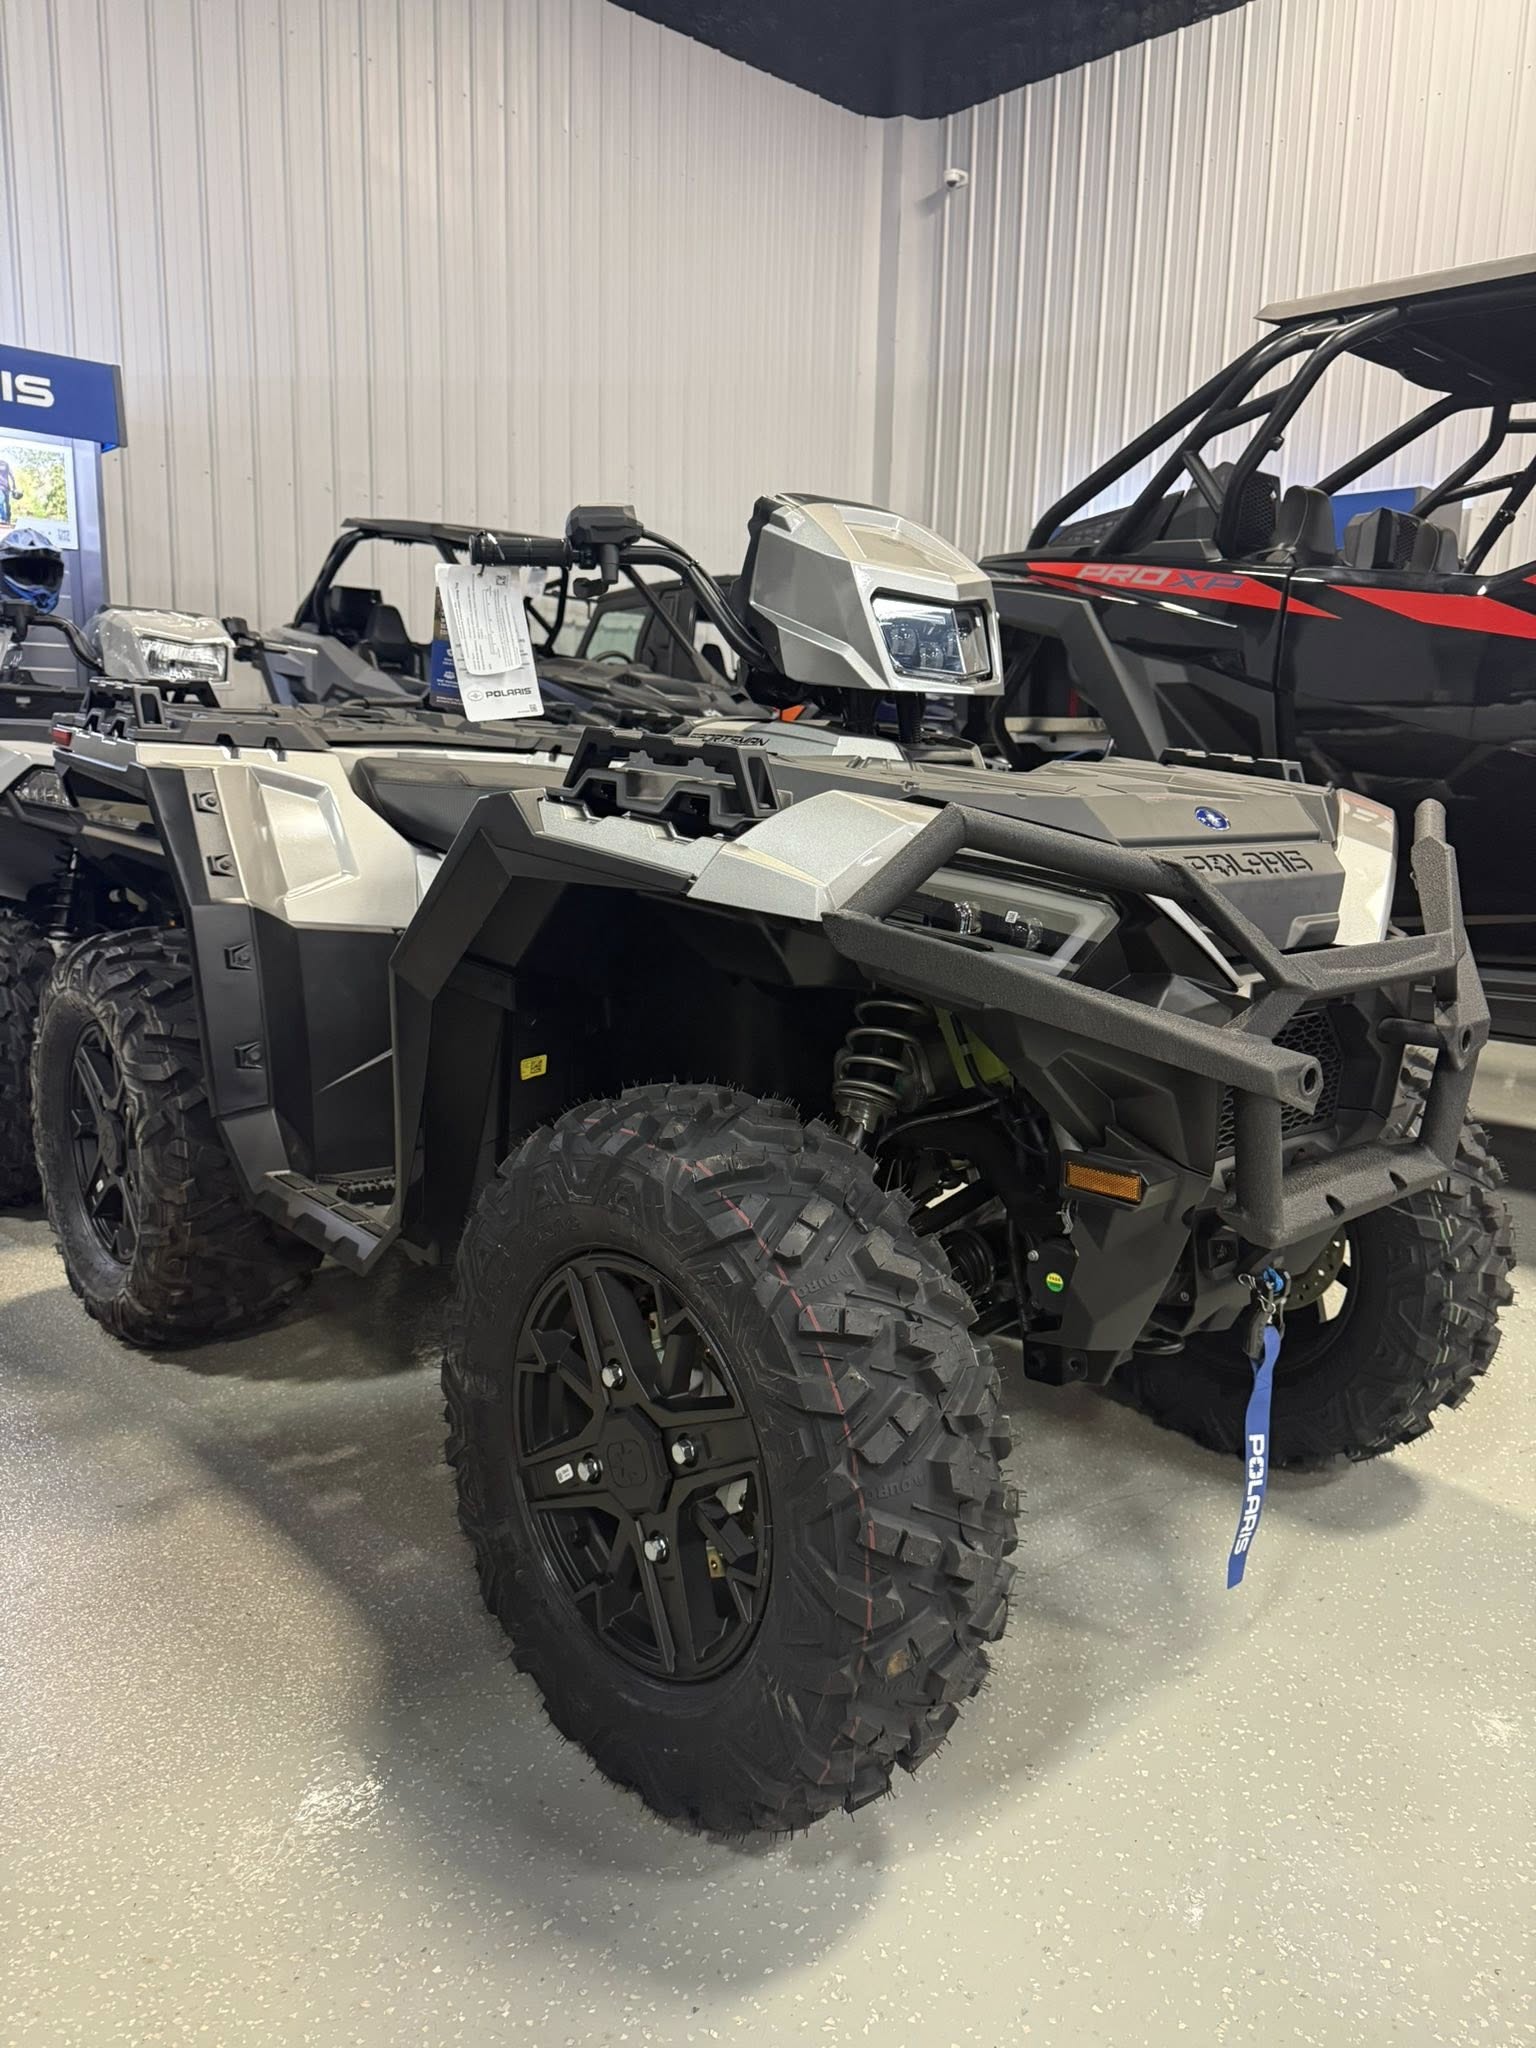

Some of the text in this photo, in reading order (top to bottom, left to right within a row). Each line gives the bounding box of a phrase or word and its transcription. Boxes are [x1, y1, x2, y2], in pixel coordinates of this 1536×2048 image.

[1, 370, 55, 408] IS
[1075, 563, 1245, 591] PRO XP
[485, 687, 533, 698] POLARIS
[1183, 850, 1314, 877] POLARIS
[1233, 1433, 1266, 1556] POLARIS
